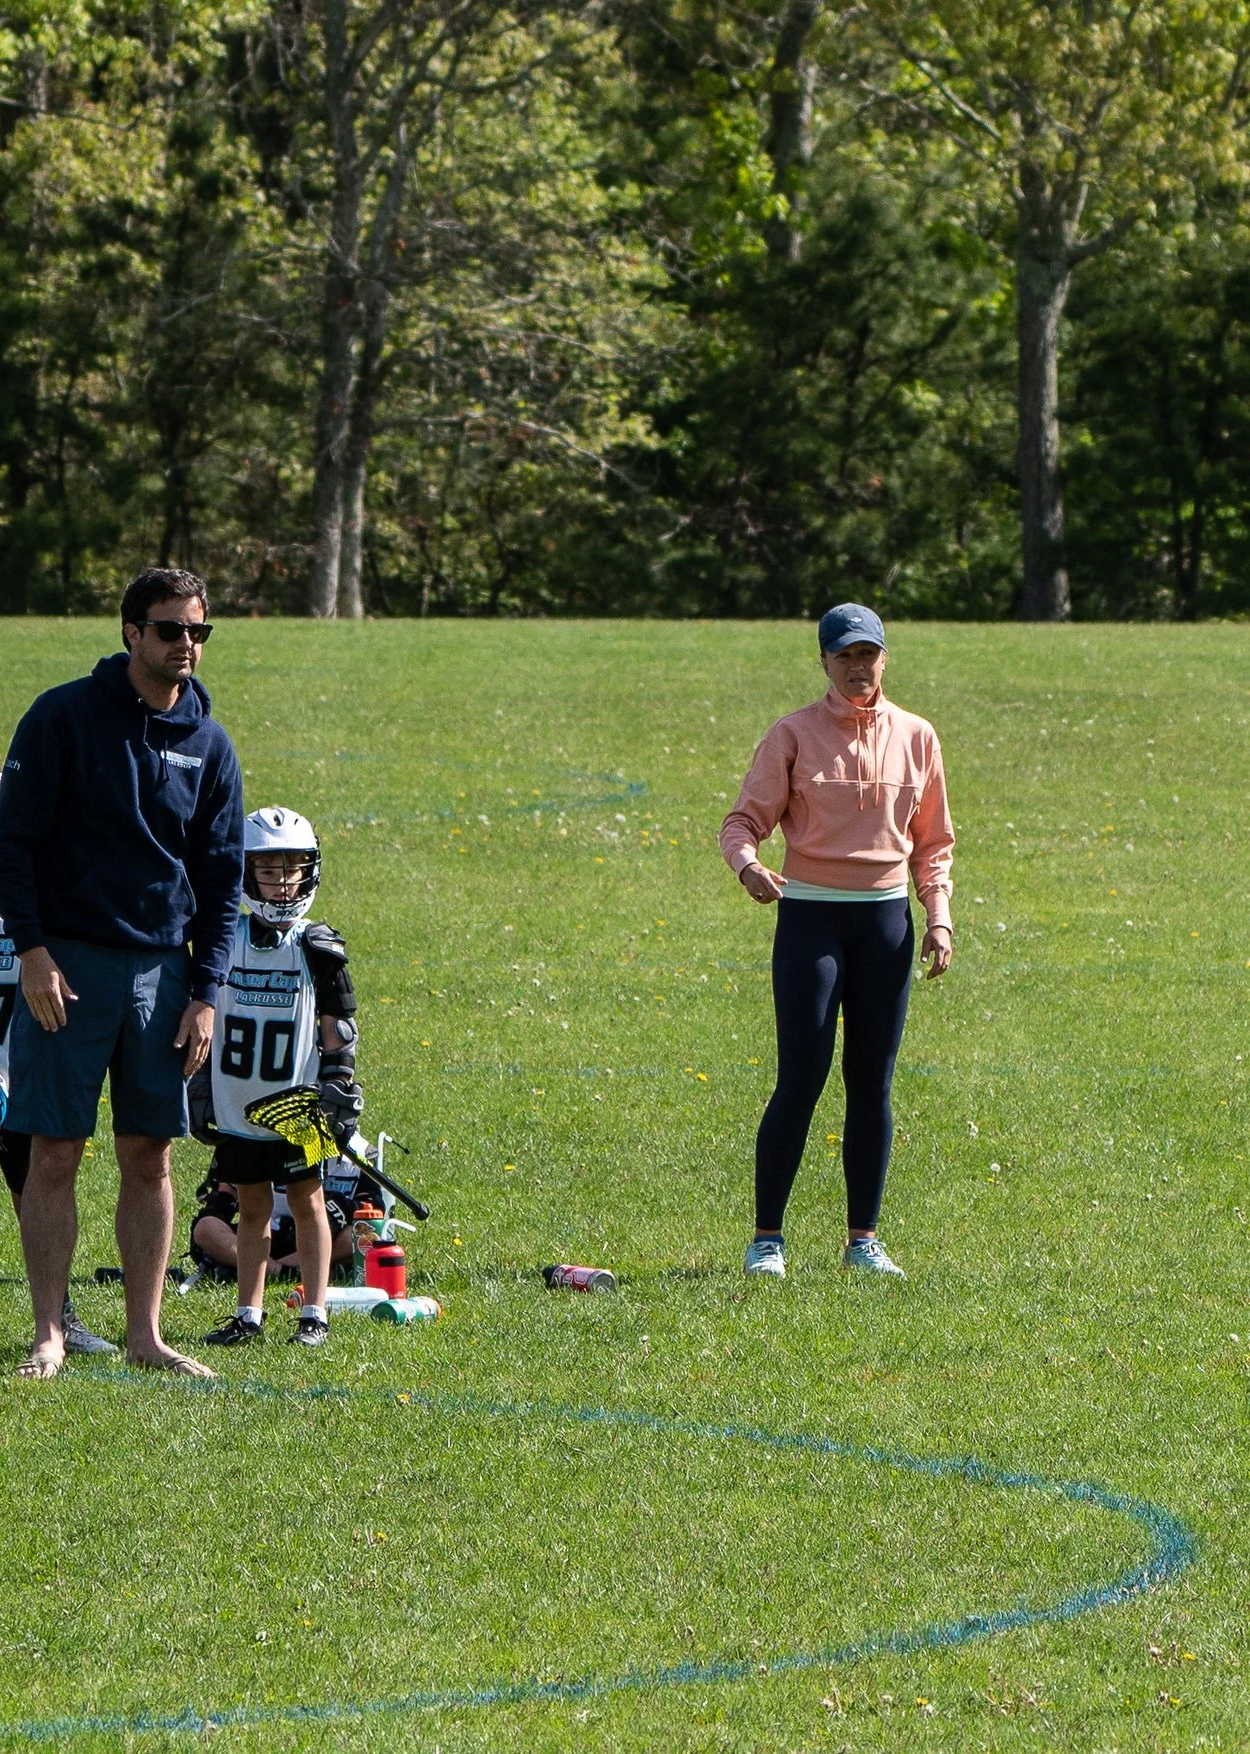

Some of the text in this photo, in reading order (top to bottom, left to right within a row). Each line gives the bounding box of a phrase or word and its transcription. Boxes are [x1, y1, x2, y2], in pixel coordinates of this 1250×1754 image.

[229, 971, 300, 993] ower Cap
[236, 991, 292, 1004] LACROSSE
[220, 1014, 295, 1082] 80
[325, 1199, 348, 1229] STX
